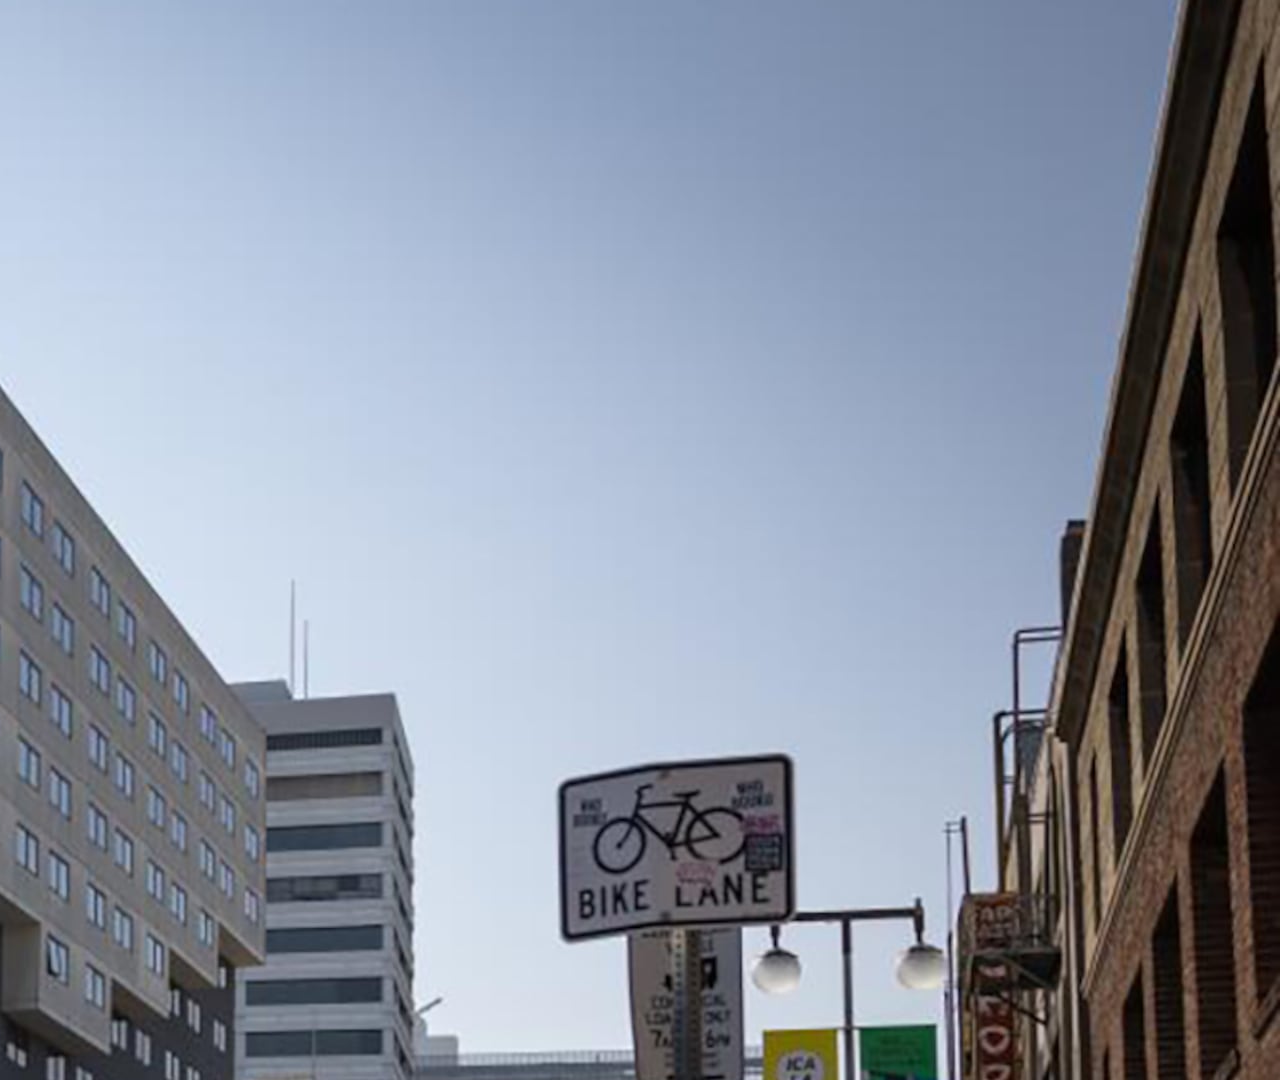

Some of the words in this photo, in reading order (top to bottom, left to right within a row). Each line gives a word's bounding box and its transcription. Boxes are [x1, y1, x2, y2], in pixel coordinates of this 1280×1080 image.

[578, 879, 650, 919] BIKE
[675, 872, 771, 908] LANE
[786, 1056, 816, 1071] ICA
